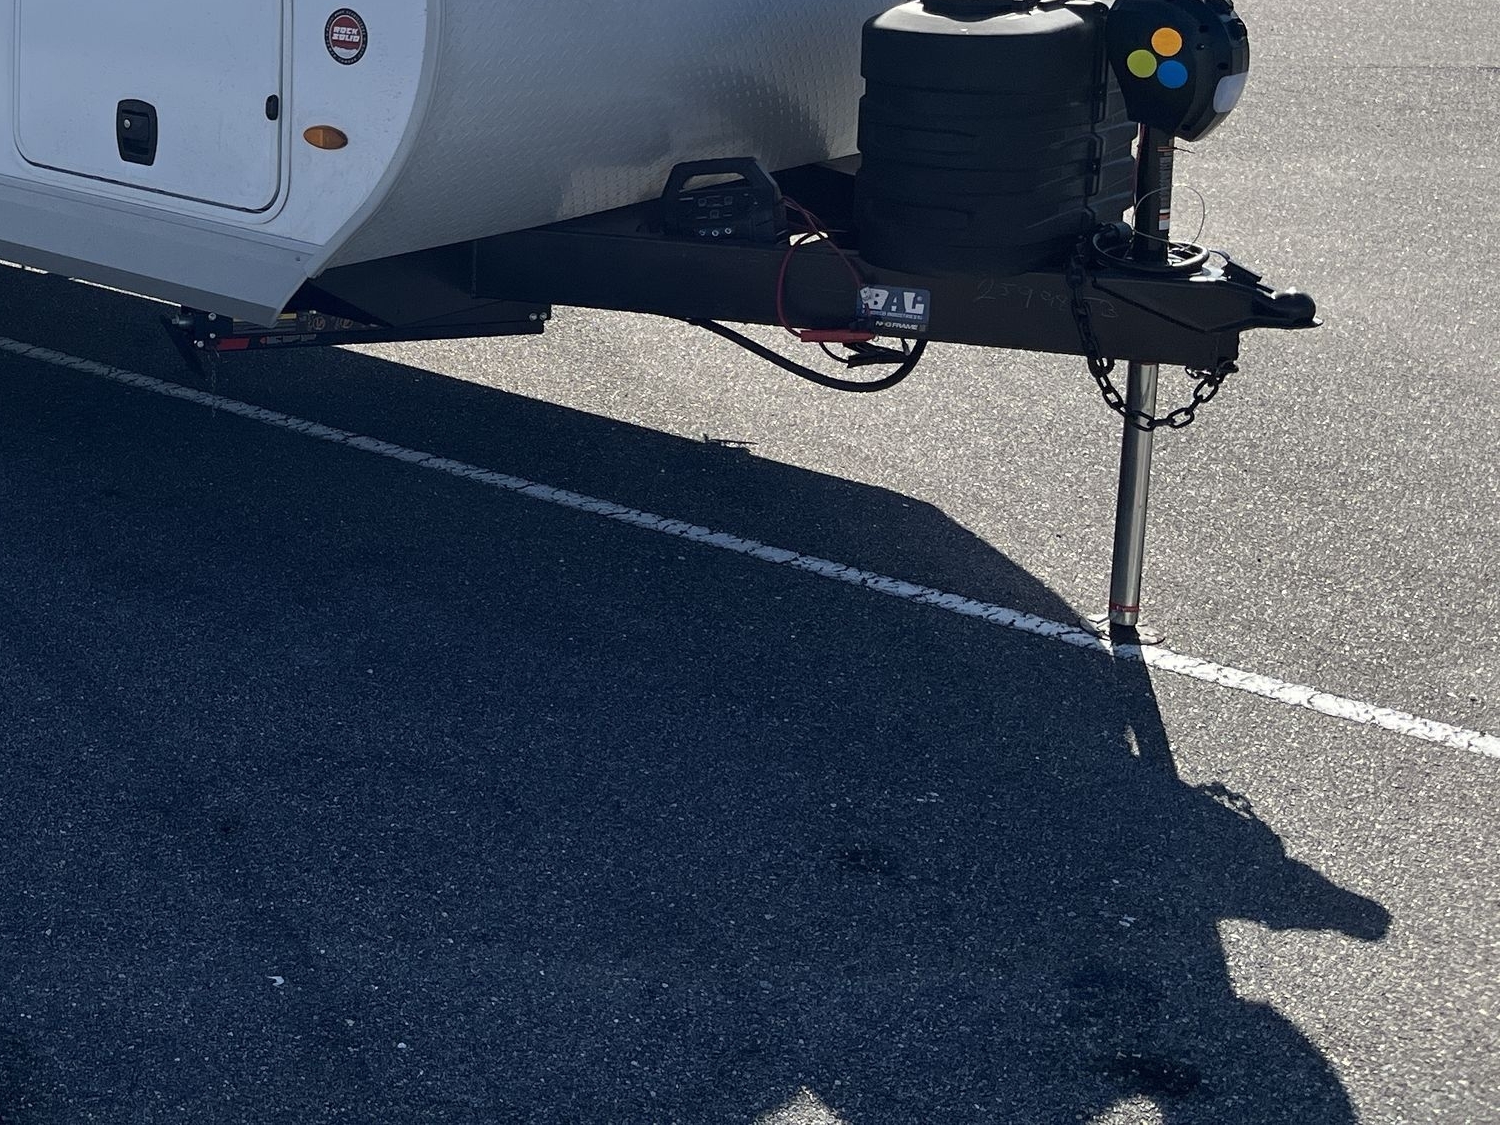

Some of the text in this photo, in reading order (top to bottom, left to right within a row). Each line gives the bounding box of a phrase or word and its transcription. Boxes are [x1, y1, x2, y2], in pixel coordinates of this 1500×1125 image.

[333, 26, 359, 35] ROCK
[331, 33, 360, 42] SOLID
[862, 287, 925, 314] BAL
